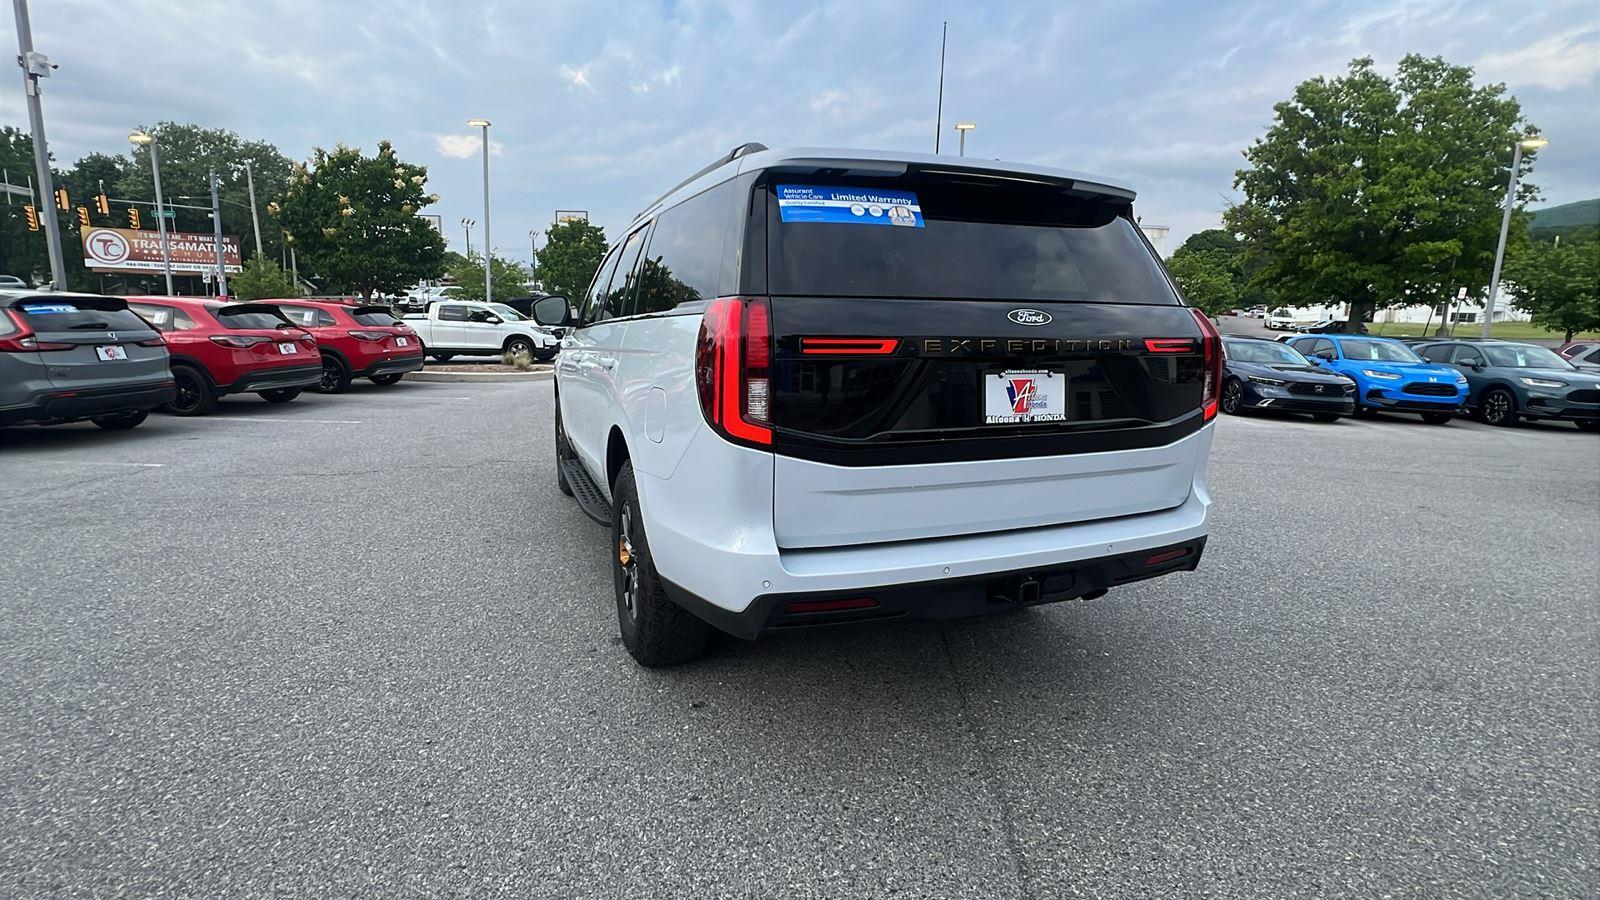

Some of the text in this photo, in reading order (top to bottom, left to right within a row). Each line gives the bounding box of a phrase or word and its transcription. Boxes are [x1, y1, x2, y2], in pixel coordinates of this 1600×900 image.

[831, 193, 912, 205] Limited Warranty
[171, 251, 238, 259] CHURH
[1017, 310, 1044, 323] Ford
[924, 339, 1131, 352] EXPEDITION
[986, 415, 1020, 424] Altoona
[1034, 413, 1066, 422] HONDA
